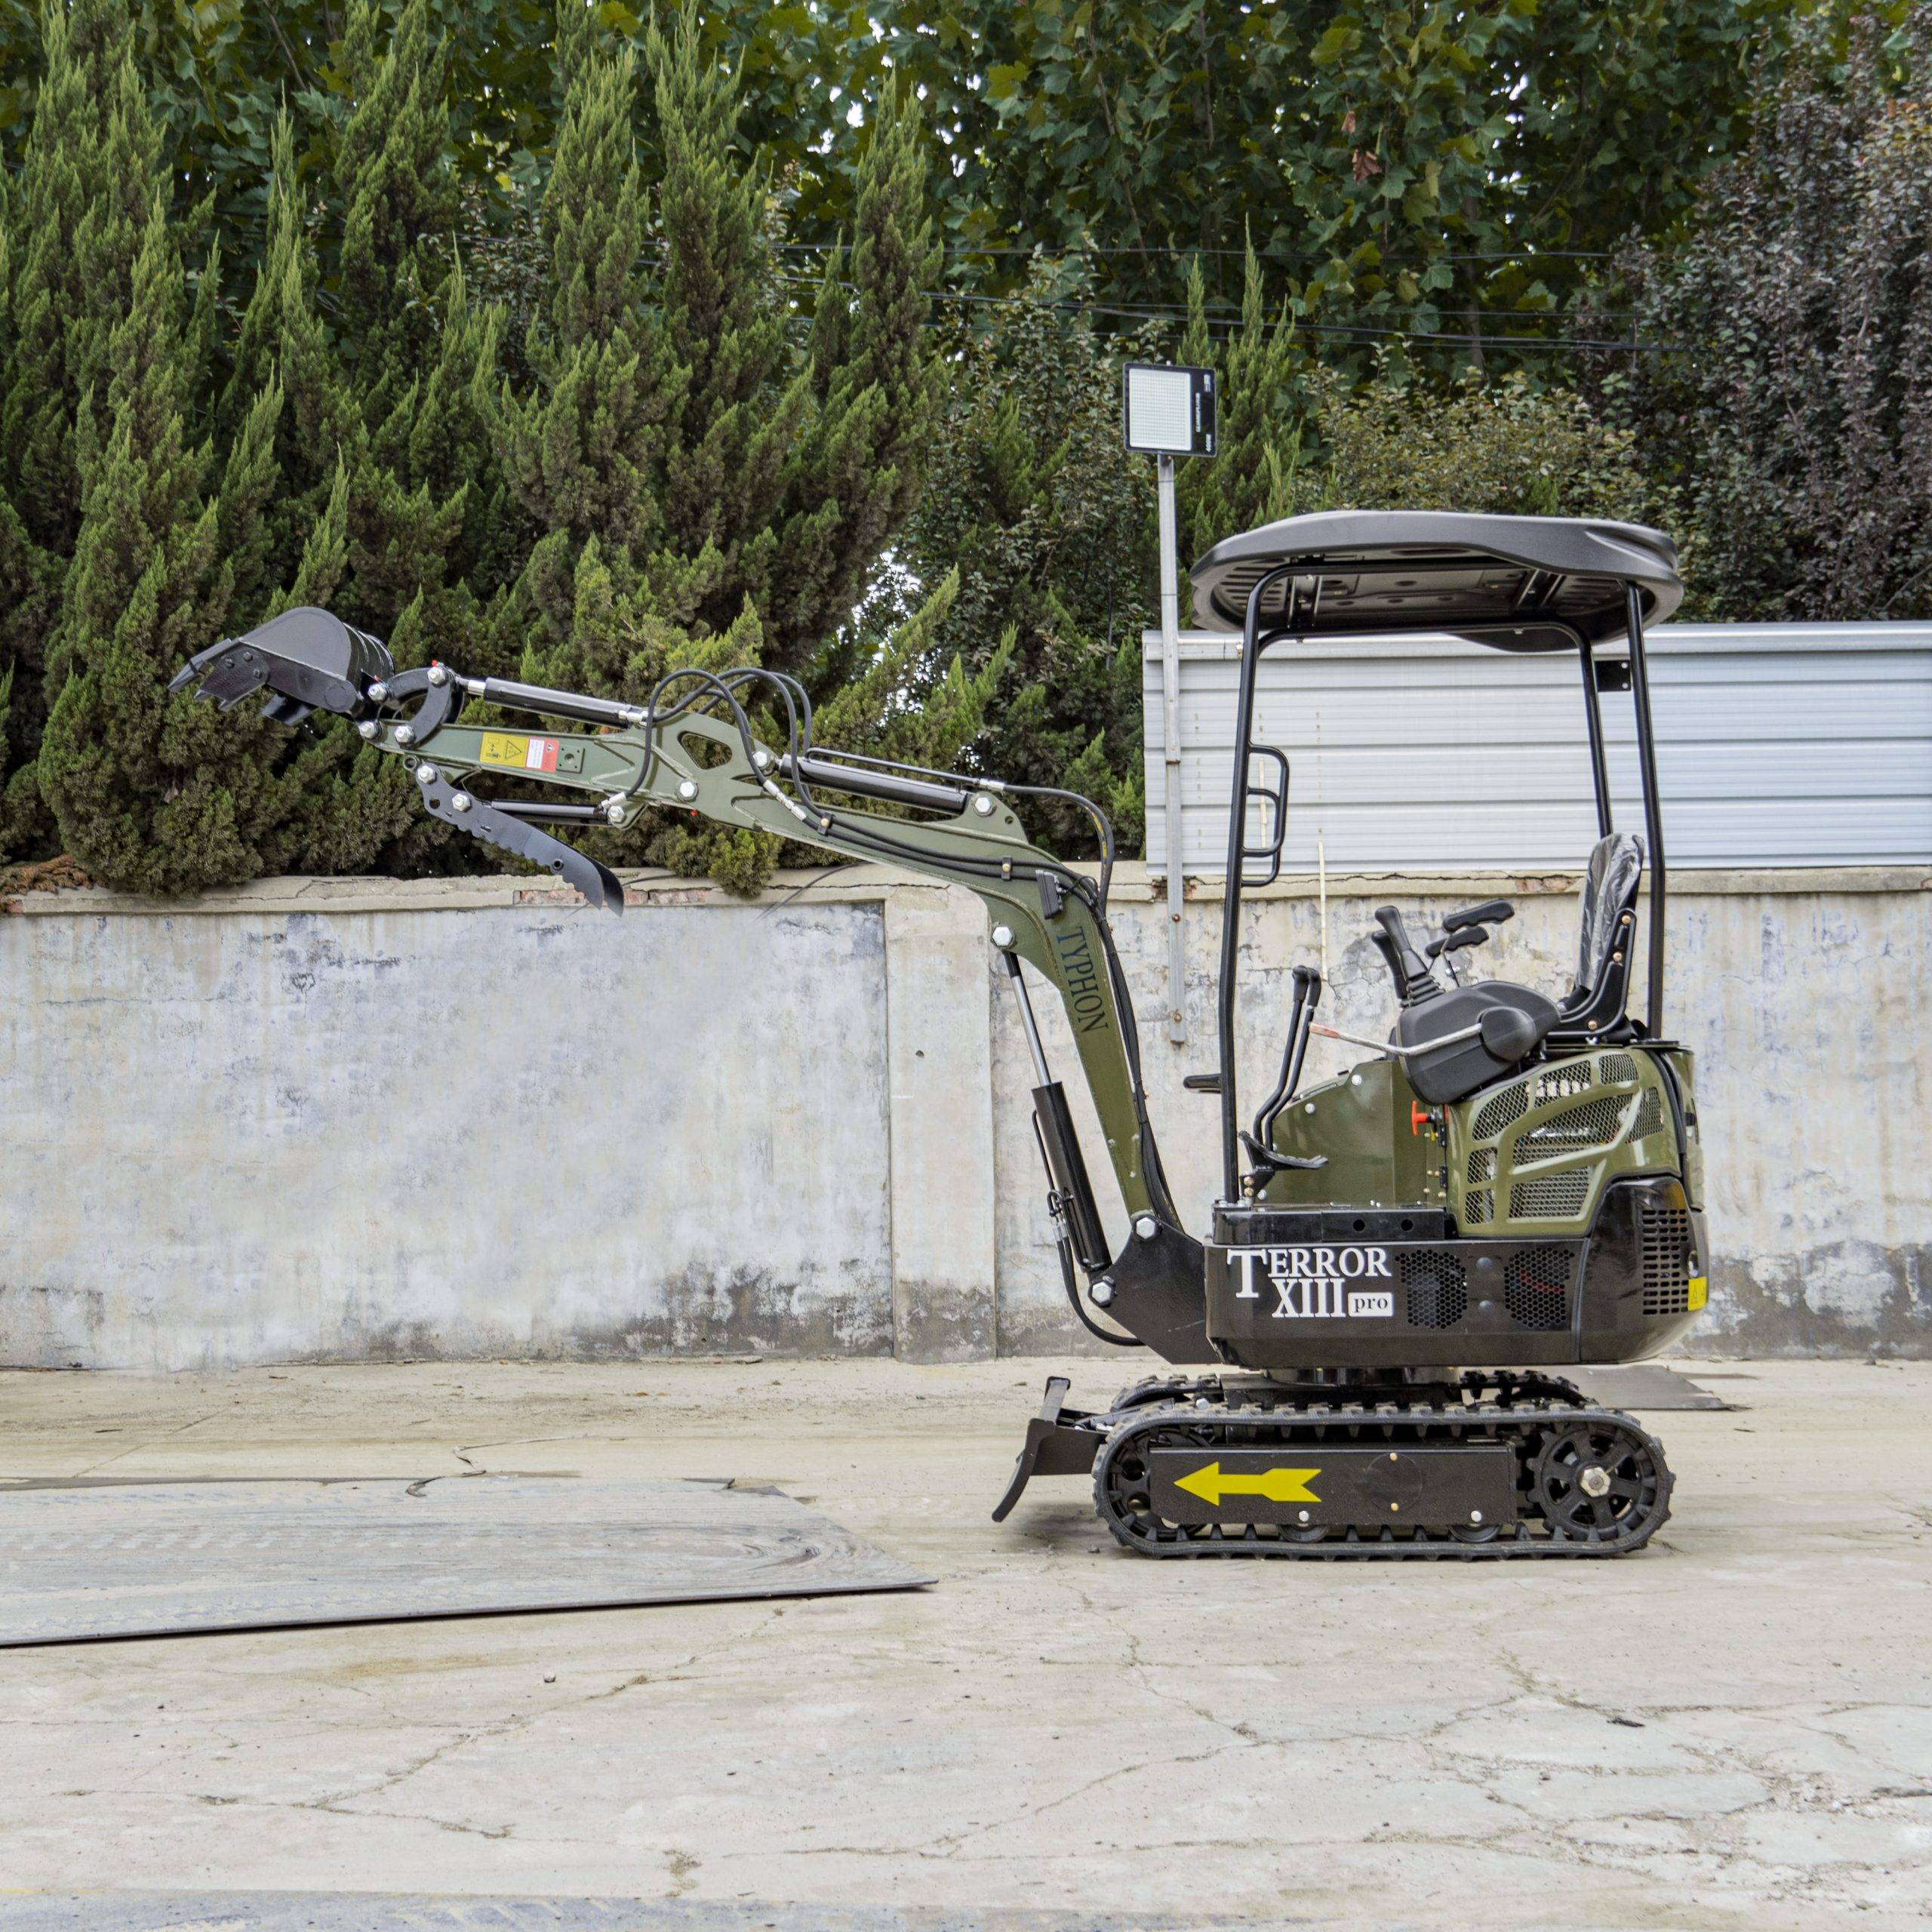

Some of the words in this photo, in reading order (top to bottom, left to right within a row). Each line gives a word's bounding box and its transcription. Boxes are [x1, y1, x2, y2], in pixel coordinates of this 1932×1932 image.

[1057, 926, 1109, 1033] TYPHON
[1226, 1247, 1392, 1298] TERROR
[1272, 1278, 1346, 1318] XIII
[1353, 1297, 1389, 1313] pro
